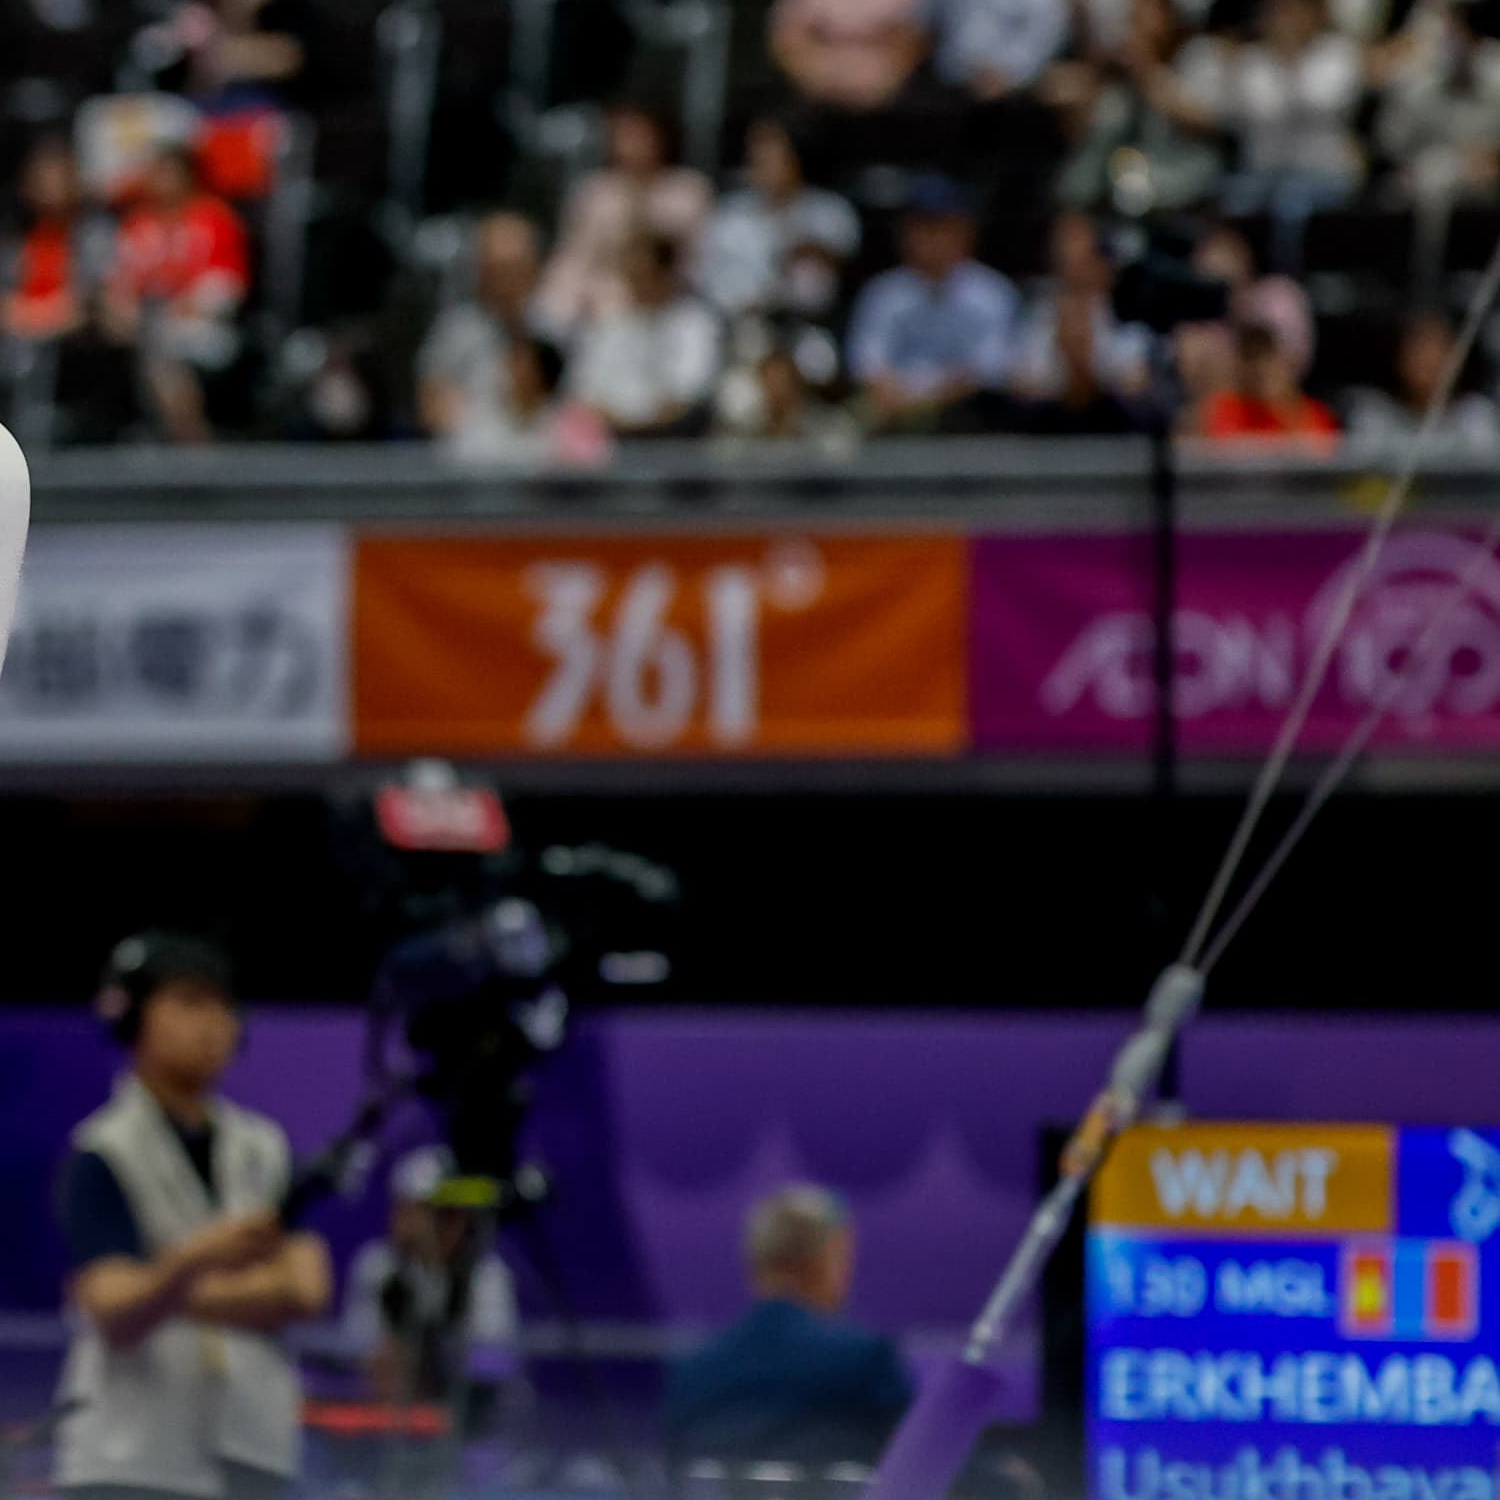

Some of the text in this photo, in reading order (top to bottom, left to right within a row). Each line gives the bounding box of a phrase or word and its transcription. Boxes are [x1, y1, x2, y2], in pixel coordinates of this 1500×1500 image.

[1148, 1146, 1338, 1219] WAIT
[1215, 1258, 1331, 1318] MGL
[1102, 1348, 1500, 1426] ERKHEMBA
